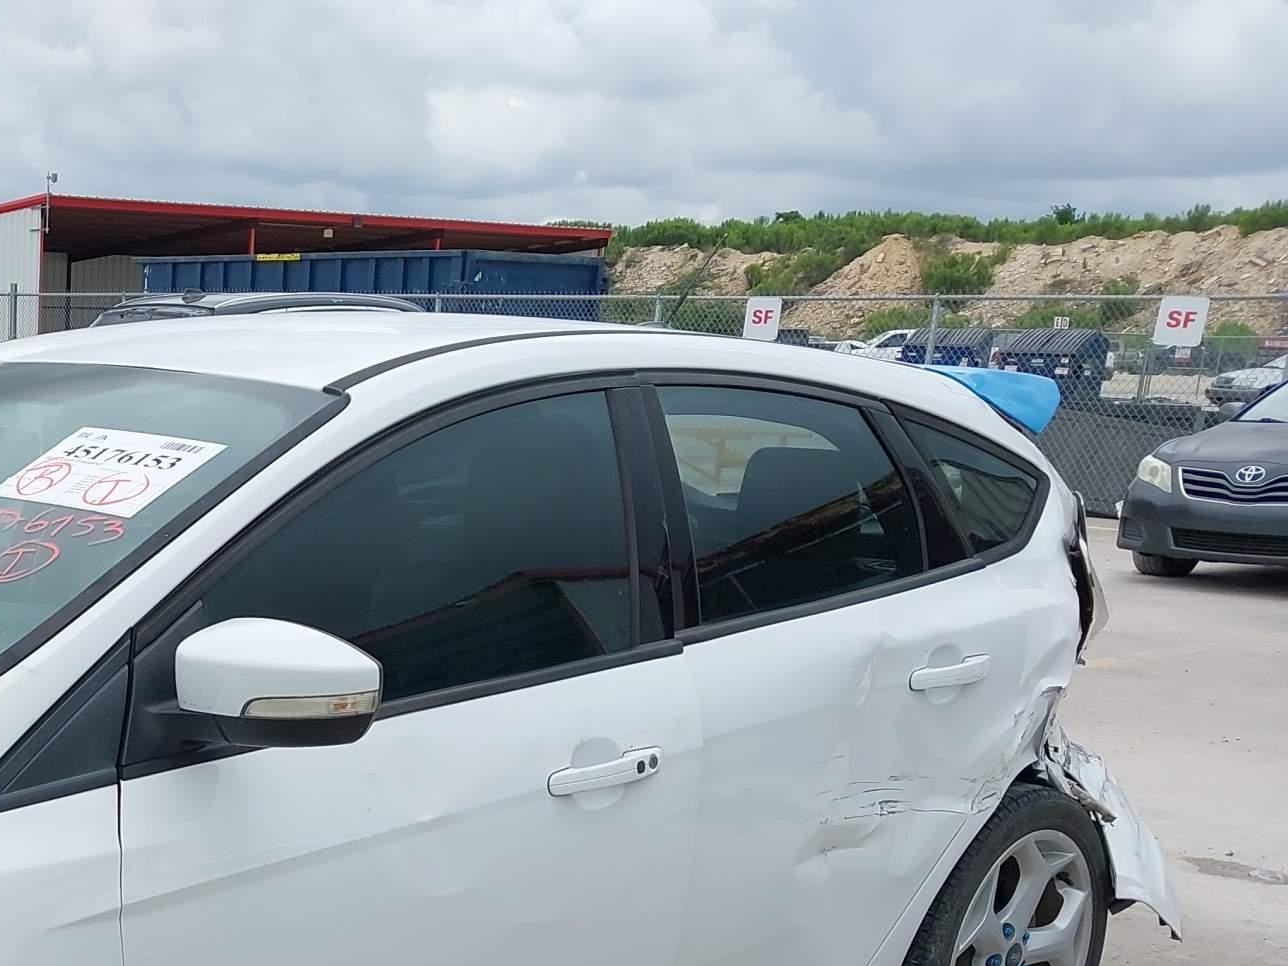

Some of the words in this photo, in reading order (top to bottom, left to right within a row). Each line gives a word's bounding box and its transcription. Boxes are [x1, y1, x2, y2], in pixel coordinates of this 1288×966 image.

[752, 309, 774, 325] SF
[1166, 310, 1198, 329] SF
[63, 444, 183, 470] 45176153
